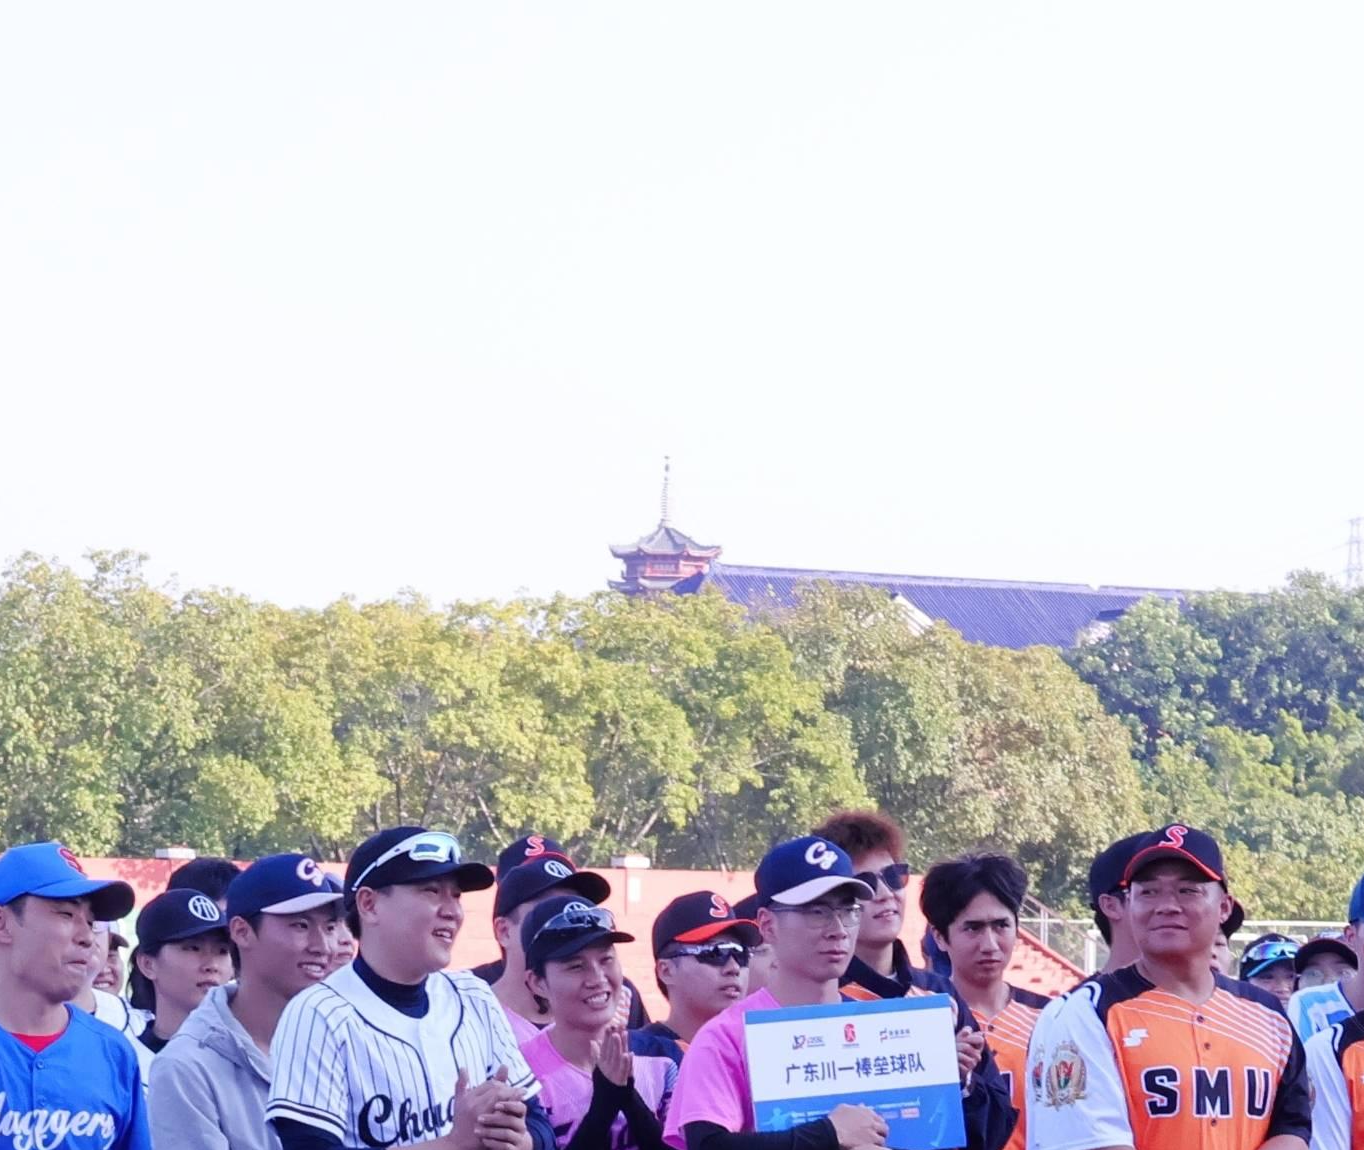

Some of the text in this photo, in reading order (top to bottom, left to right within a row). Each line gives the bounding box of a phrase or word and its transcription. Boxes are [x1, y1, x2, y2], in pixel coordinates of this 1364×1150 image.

[786, 1052, 926, 1084] 广东川一棒垒球队
[1142, 1066, 1273, 1120] SMU
